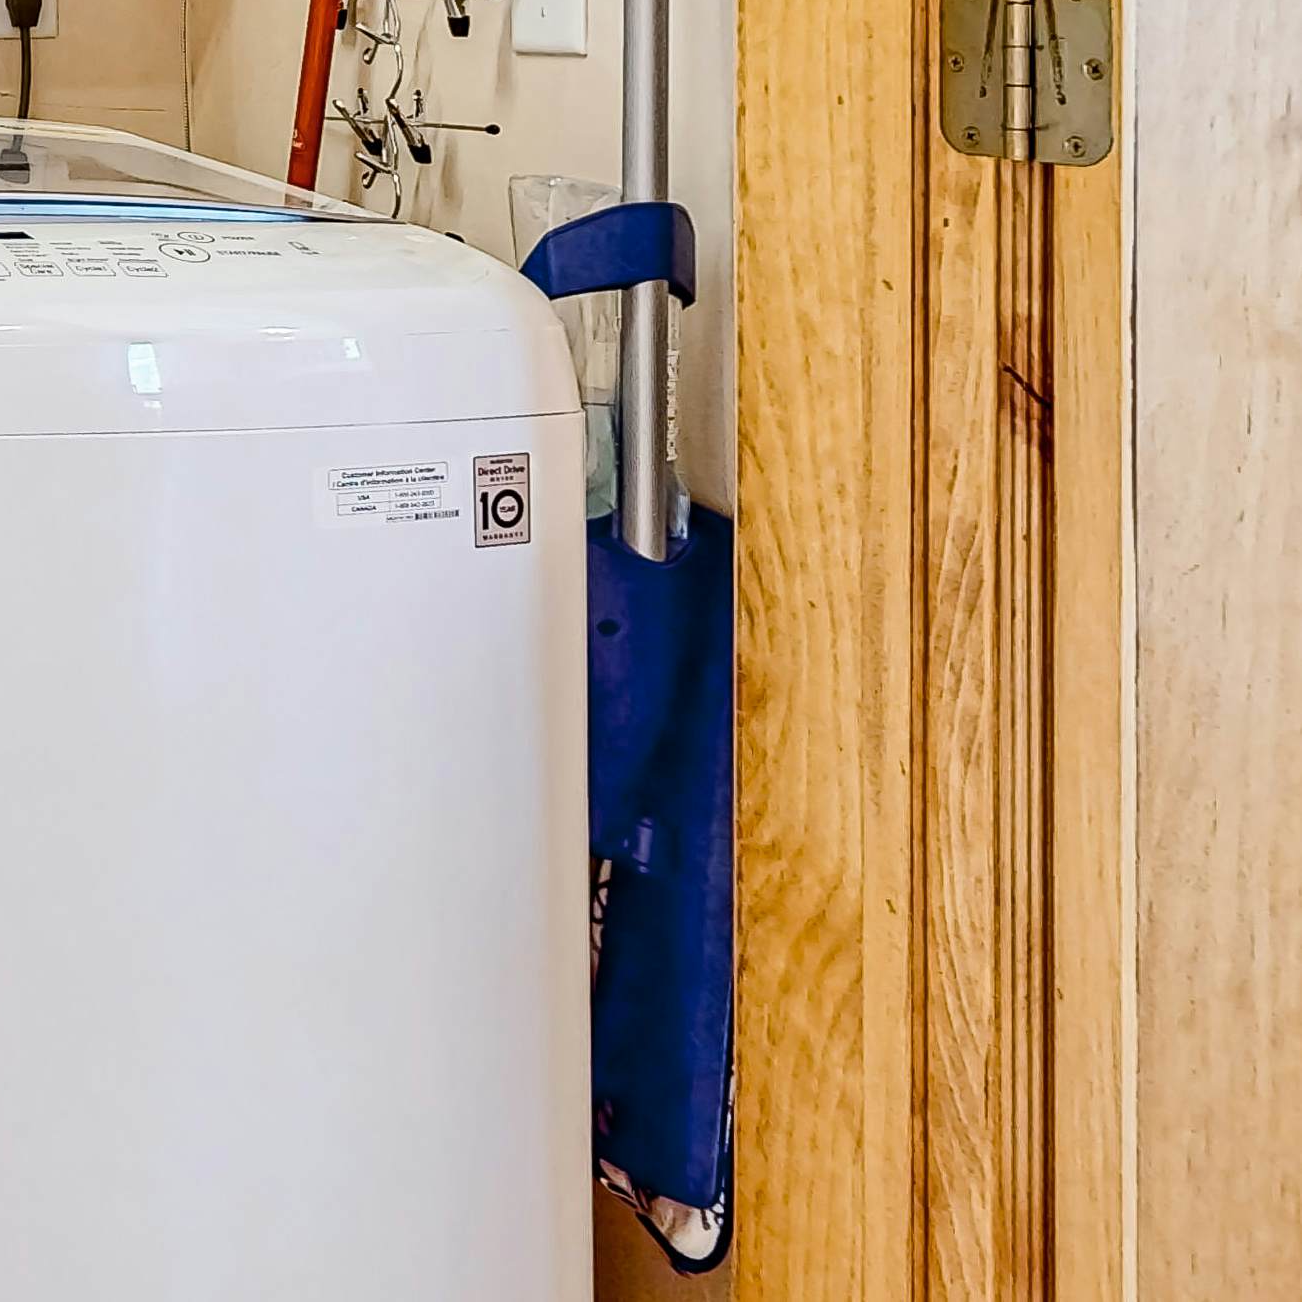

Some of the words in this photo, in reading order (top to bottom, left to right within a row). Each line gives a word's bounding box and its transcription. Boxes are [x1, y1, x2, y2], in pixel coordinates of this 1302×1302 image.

[341, 470, 374, 479] Customer
[375, 468, 413, 477] Information
[414, 466, 436, 474] Center
[477, 466, 502, 476] Direct
[504, 465, 526, 475] Drive
[479, 489, 525, 530] 10
[482, 531, 524, 541] WARRANTY
